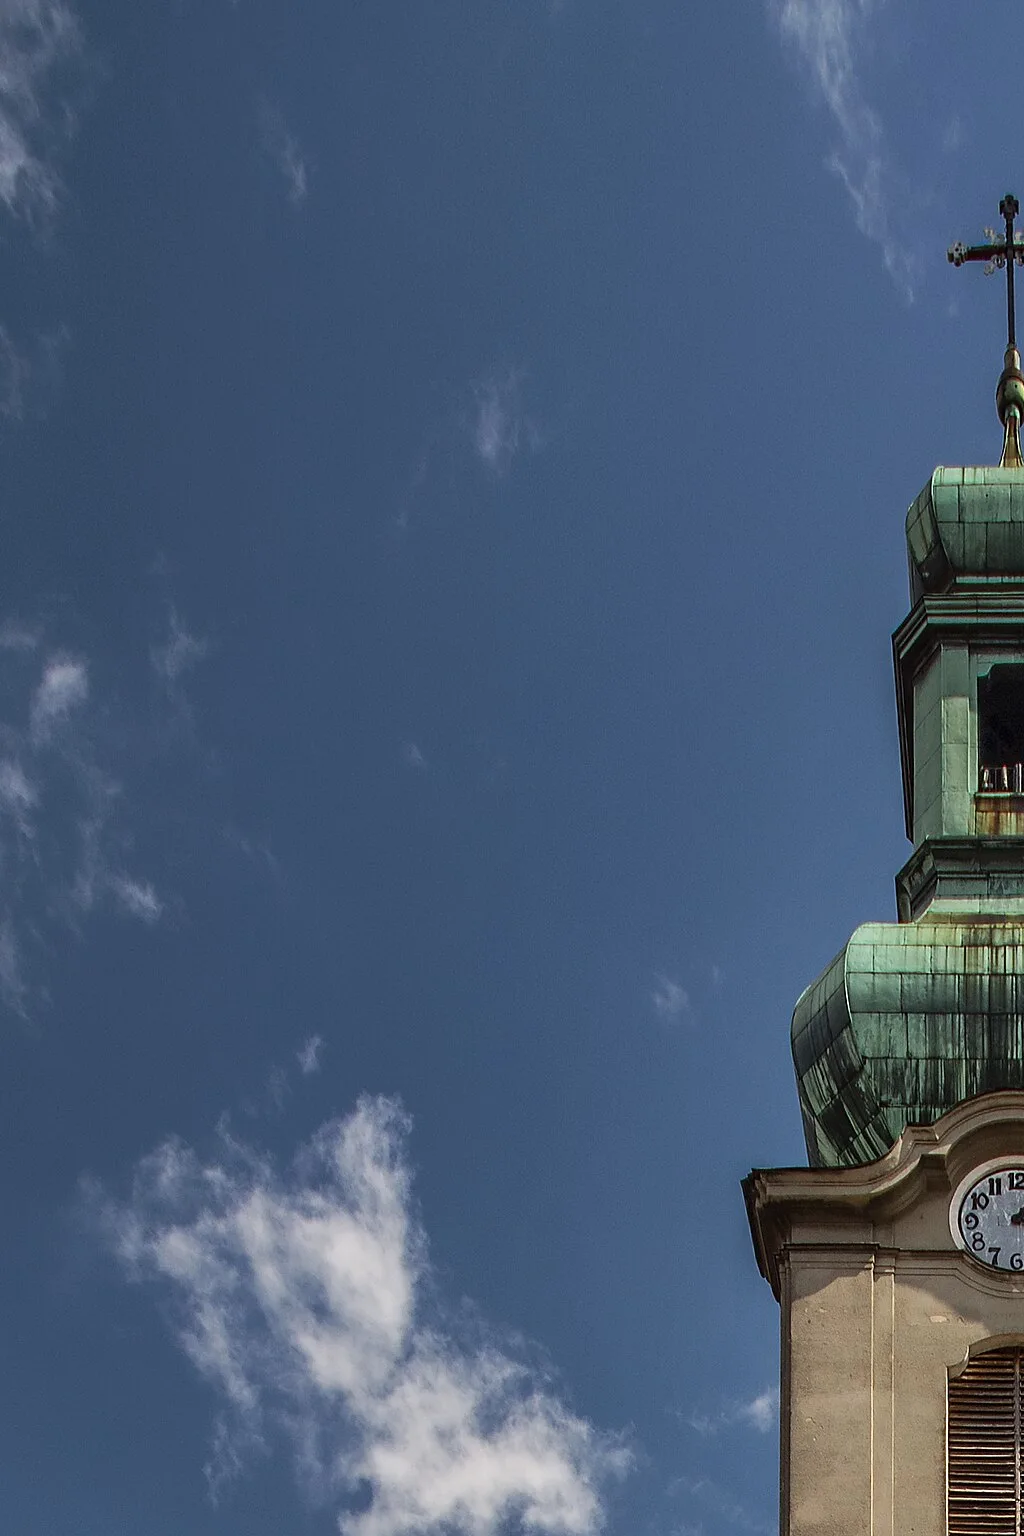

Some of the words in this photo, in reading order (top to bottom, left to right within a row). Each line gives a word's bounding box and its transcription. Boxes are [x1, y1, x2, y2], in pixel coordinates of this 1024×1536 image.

[988, 1177, 1002, 1196] 11
[970, 1191, 990, 1211] 10
[965, 1212, 979, 1231] 9
[972, 1232, 985, 1251] 8
[988, 1247, 1001, 1266] 7
[1010, 1253, 1024, 1270] 6
